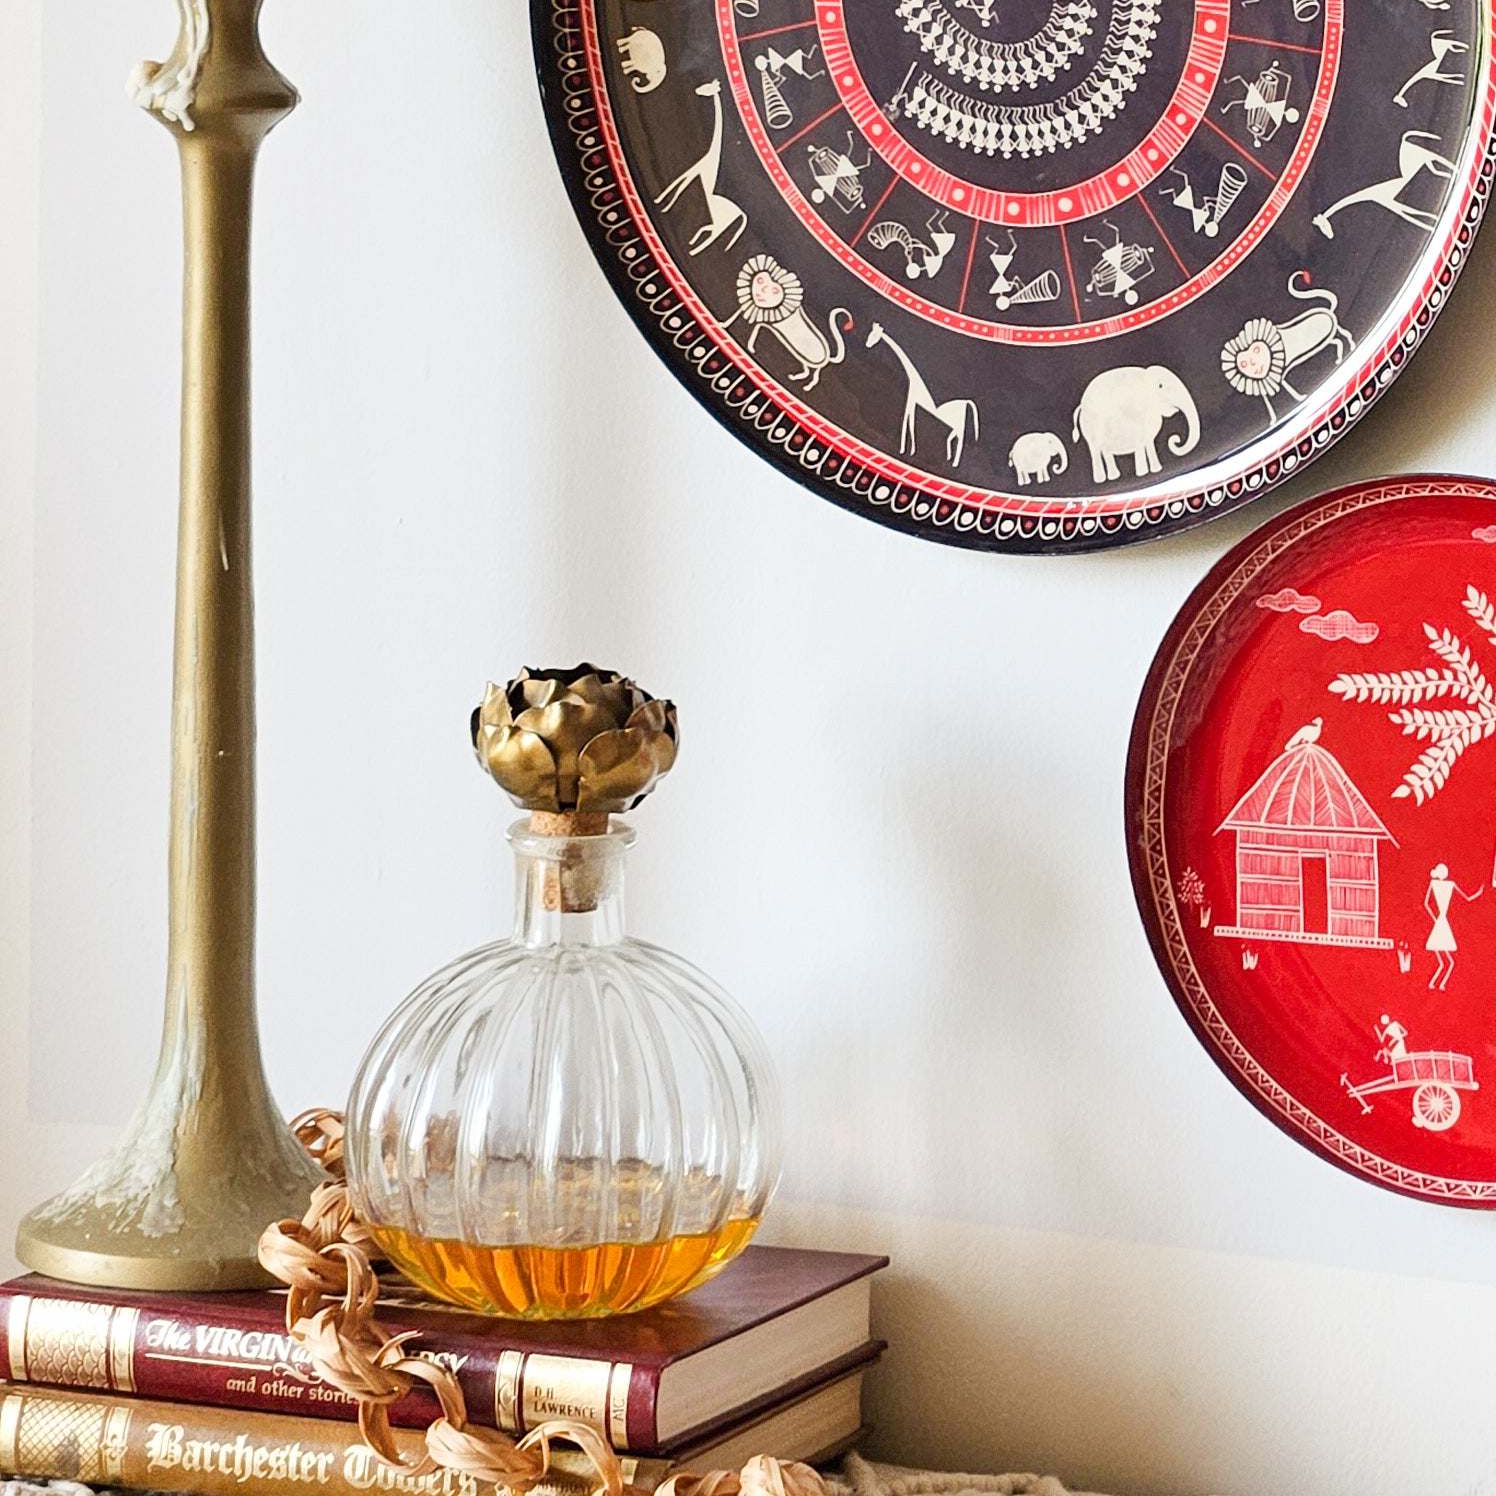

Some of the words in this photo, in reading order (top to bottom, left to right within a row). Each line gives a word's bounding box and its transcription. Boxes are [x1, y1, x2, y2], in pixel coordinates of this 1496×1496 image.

[145, 1319, 190, 1350] The
[195, 1325, 291, 1362] VIRGIN
[226, 1376, 257, 1394] and
[261, 1377, 303, 1400] other
[534, 1400, 596, 1419] LAWRENCE
[145, 1423, 333, 1485] Barchester
[343, 1443, 477, 1496] Towers
